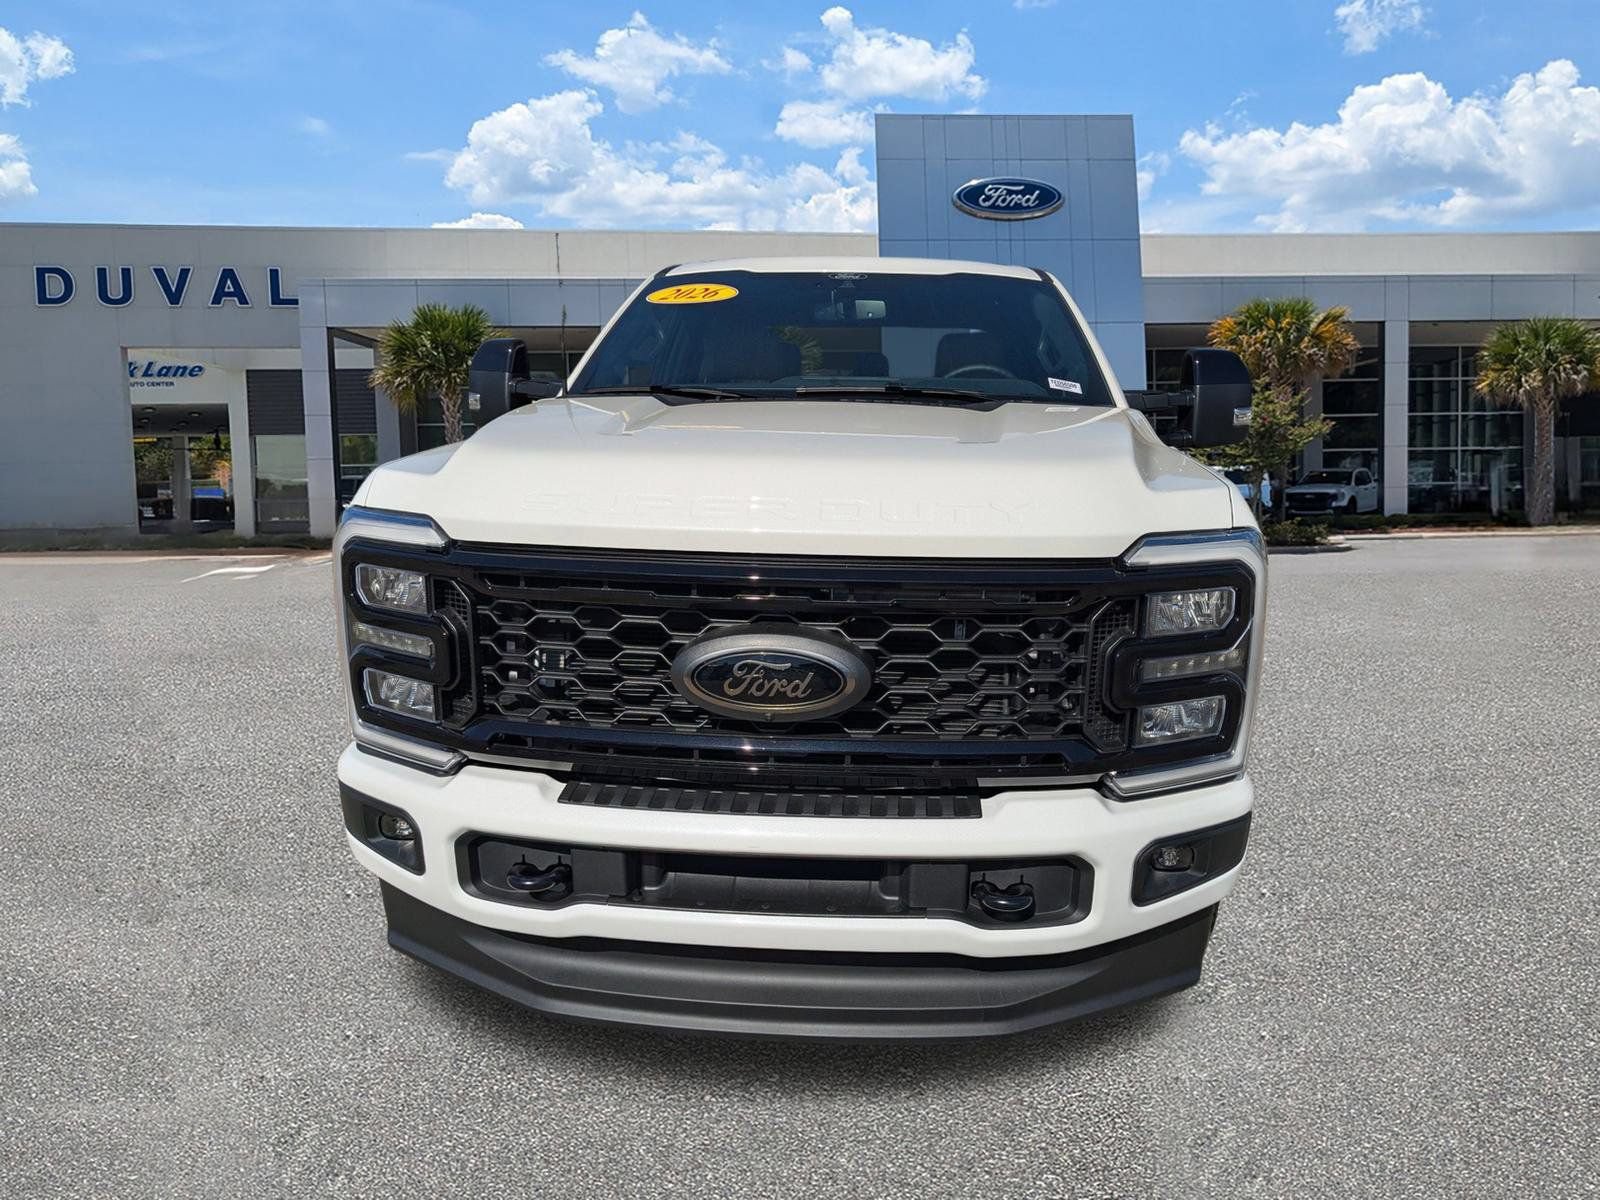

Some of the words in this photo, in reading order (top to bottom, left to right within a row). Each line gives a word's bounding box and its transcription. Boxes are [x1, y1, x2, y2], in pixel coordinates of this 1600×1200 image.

[978, 184, 1040, 207] Ford
[34, 266, 299, 307] DUVAL
[658, 287, 722, 301] 2026
[142, 361, 204, 378] Lane
[519, 490, 798, 522] SUPER
[818, 497, 1034, 525] DUTY
[723, 659, 814, 699] Ford
